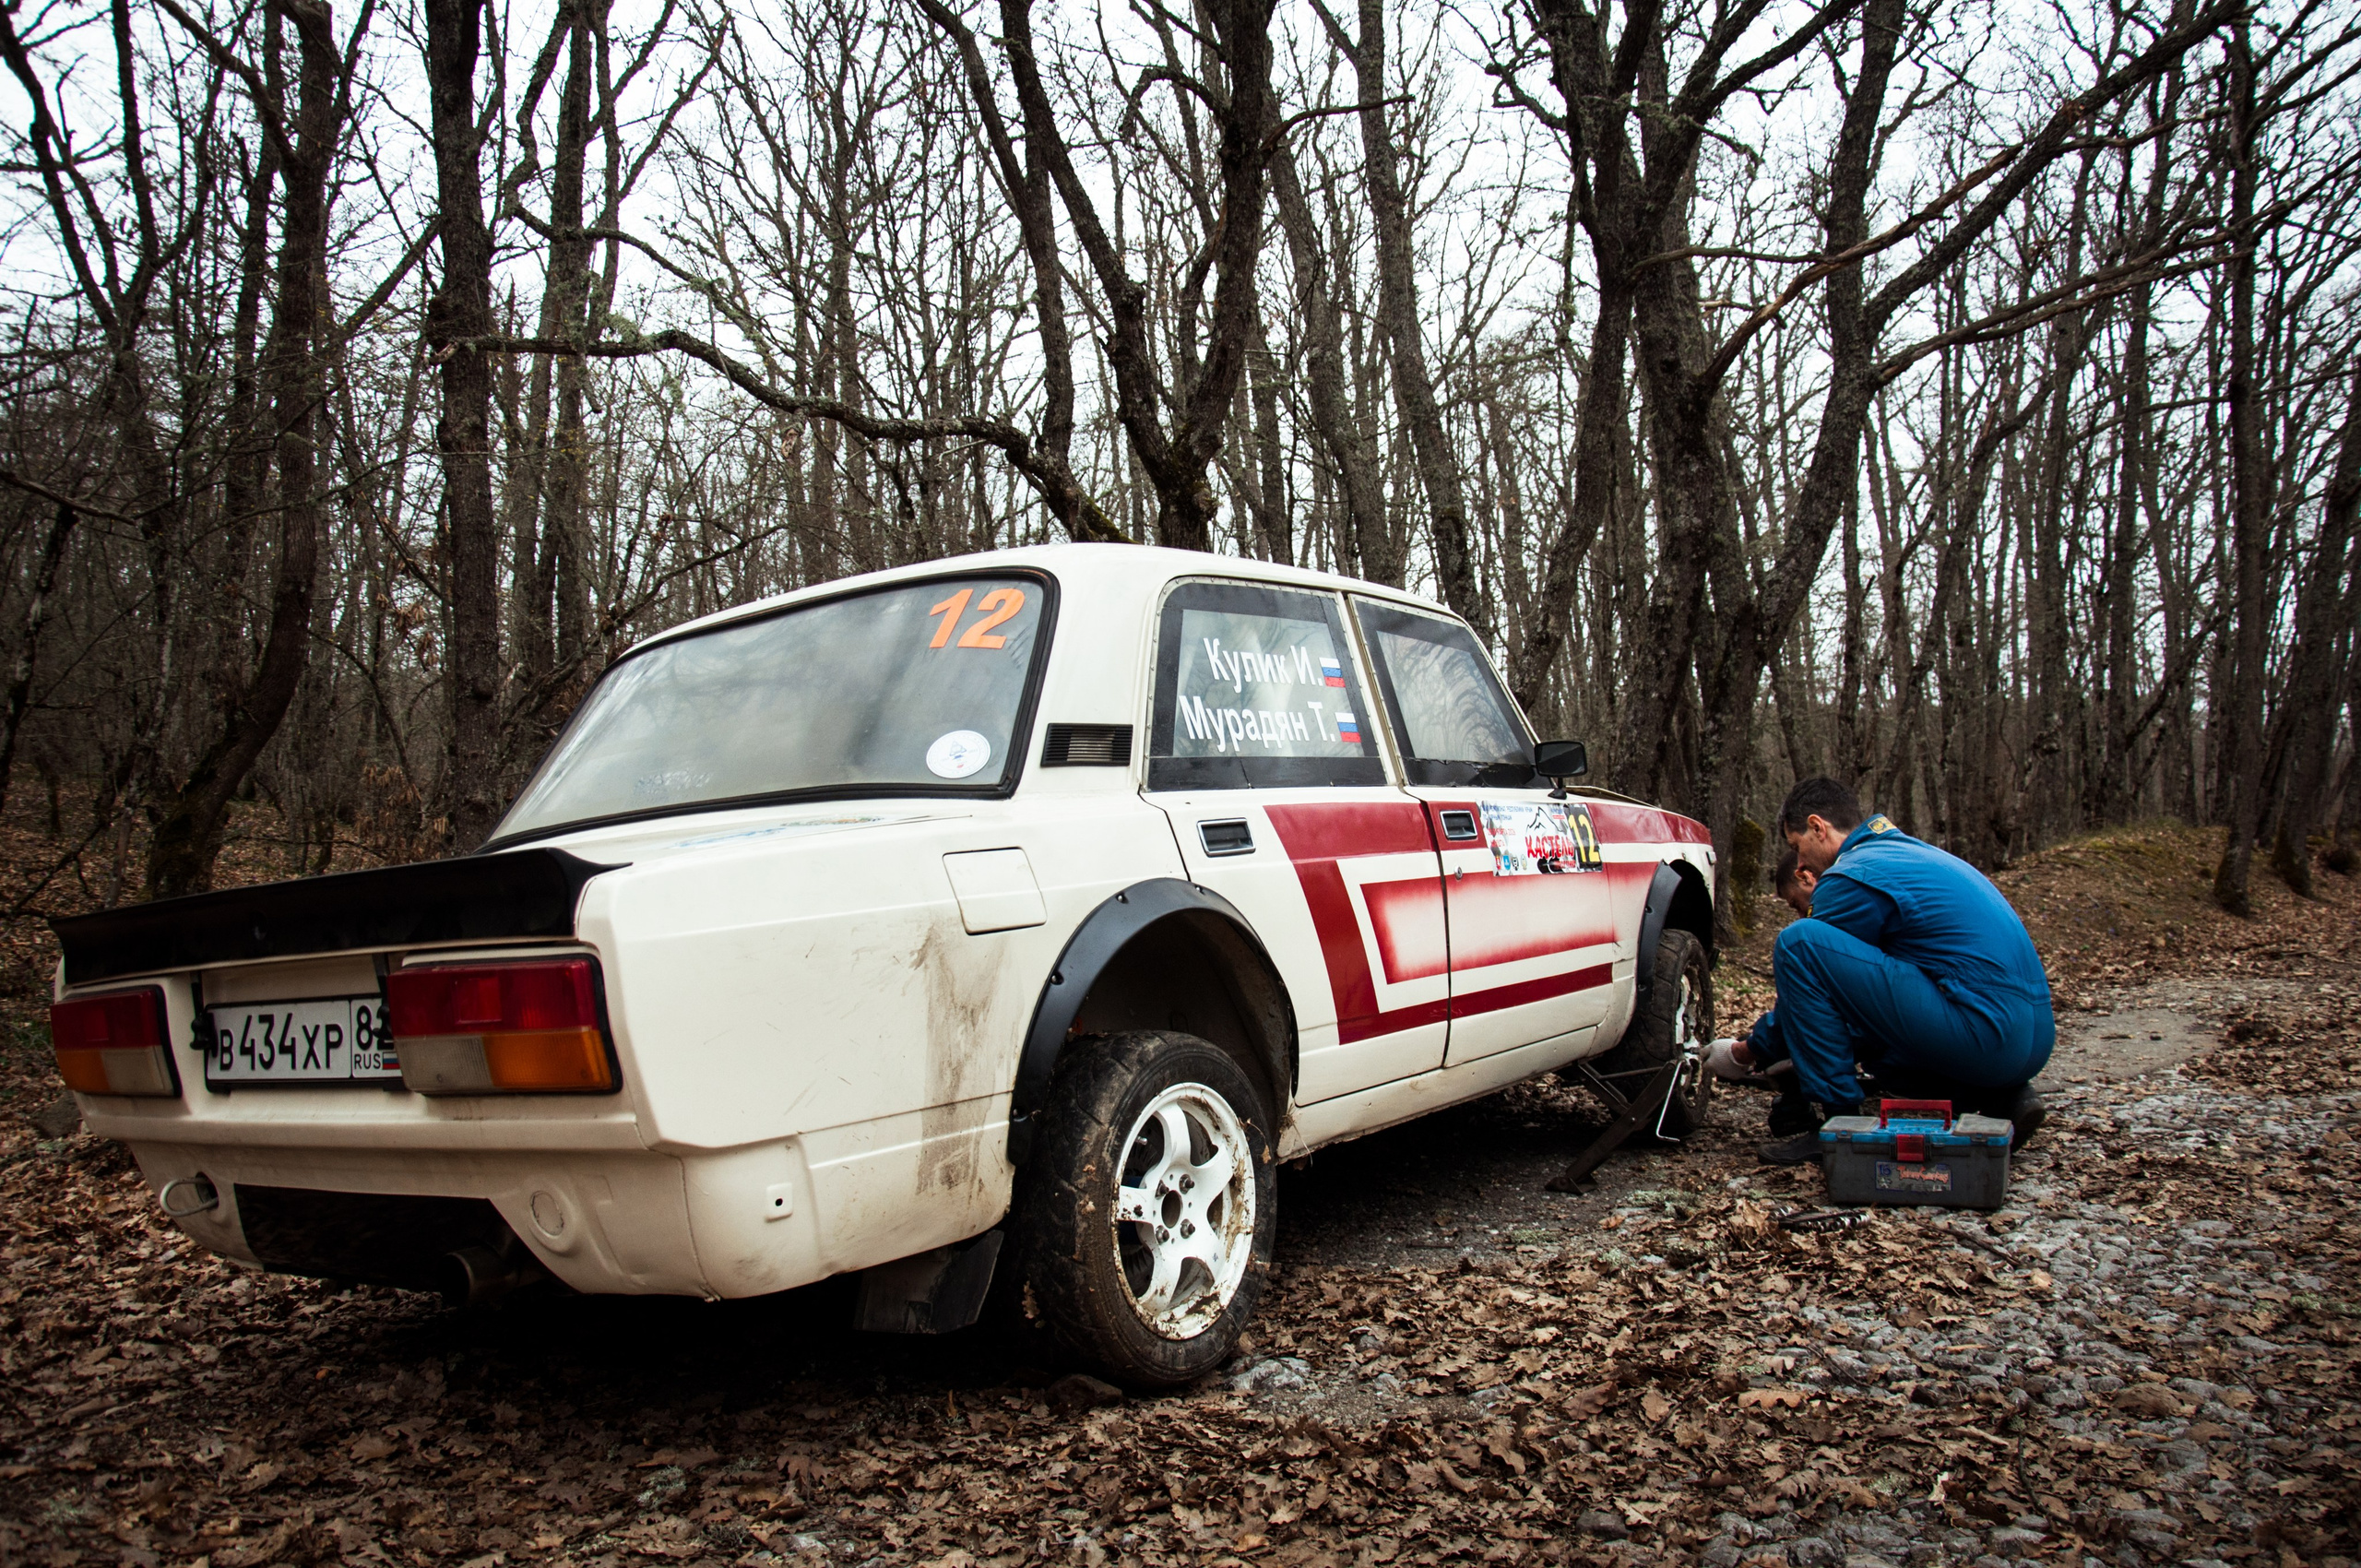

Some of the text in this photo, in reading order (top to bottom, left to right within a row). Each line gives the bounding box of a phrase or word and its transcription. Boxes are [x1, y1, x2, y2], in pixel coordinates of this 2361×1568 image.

[930, 588, 1026, 649] 12
[1203, 637, 1323, 694] Кулик И.
[1178, 695, 1336, 753] Мурадян Т.
[1525, 834, 1575, 860] КАСТЕЛЬ
[1568, 814, 1601, 863] 12
[353, 1052, 381, 1070] RUS
